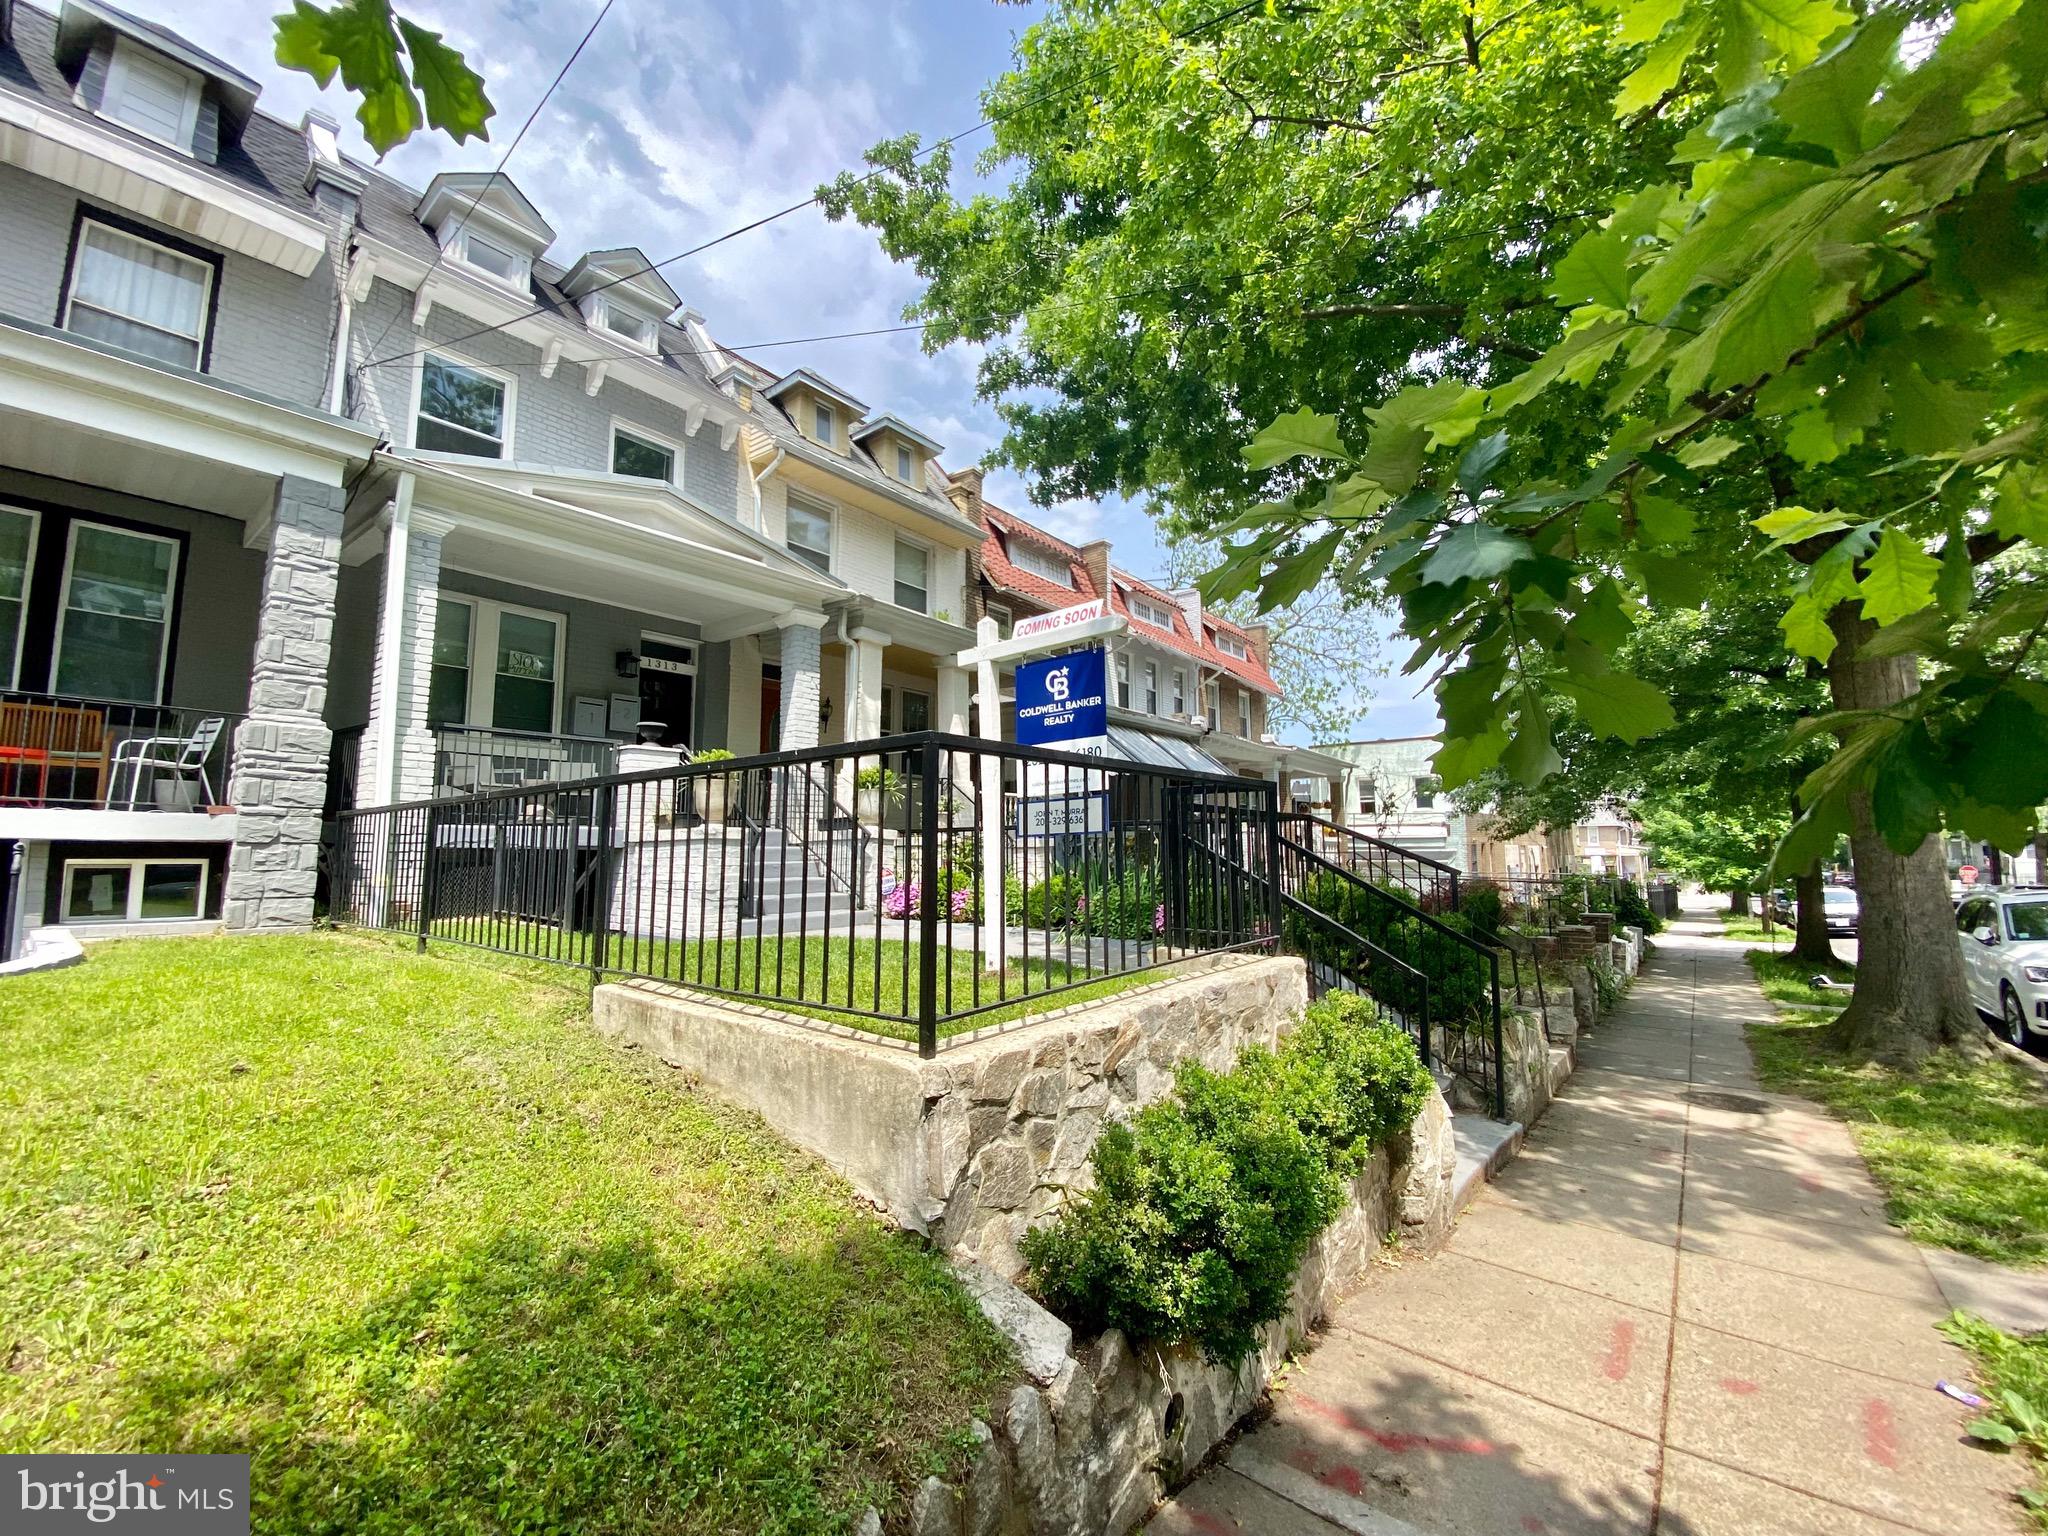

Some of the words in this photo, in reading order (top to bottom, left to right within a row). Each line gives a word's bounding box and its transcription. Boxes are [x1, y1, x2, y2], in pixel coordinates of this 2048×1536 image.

[1017, 615, 1061, 637] COMING
[1063, 606, 1098, 625] SOON
[647, 658, 678, 671] 1313
[1019, 702, 1064, 718] COLDWELL
[1065, 696, 1102, 711] BANKER
[1044, 713, 1075, 726] REALTY
[1034, 810, 1054, 818] JON
